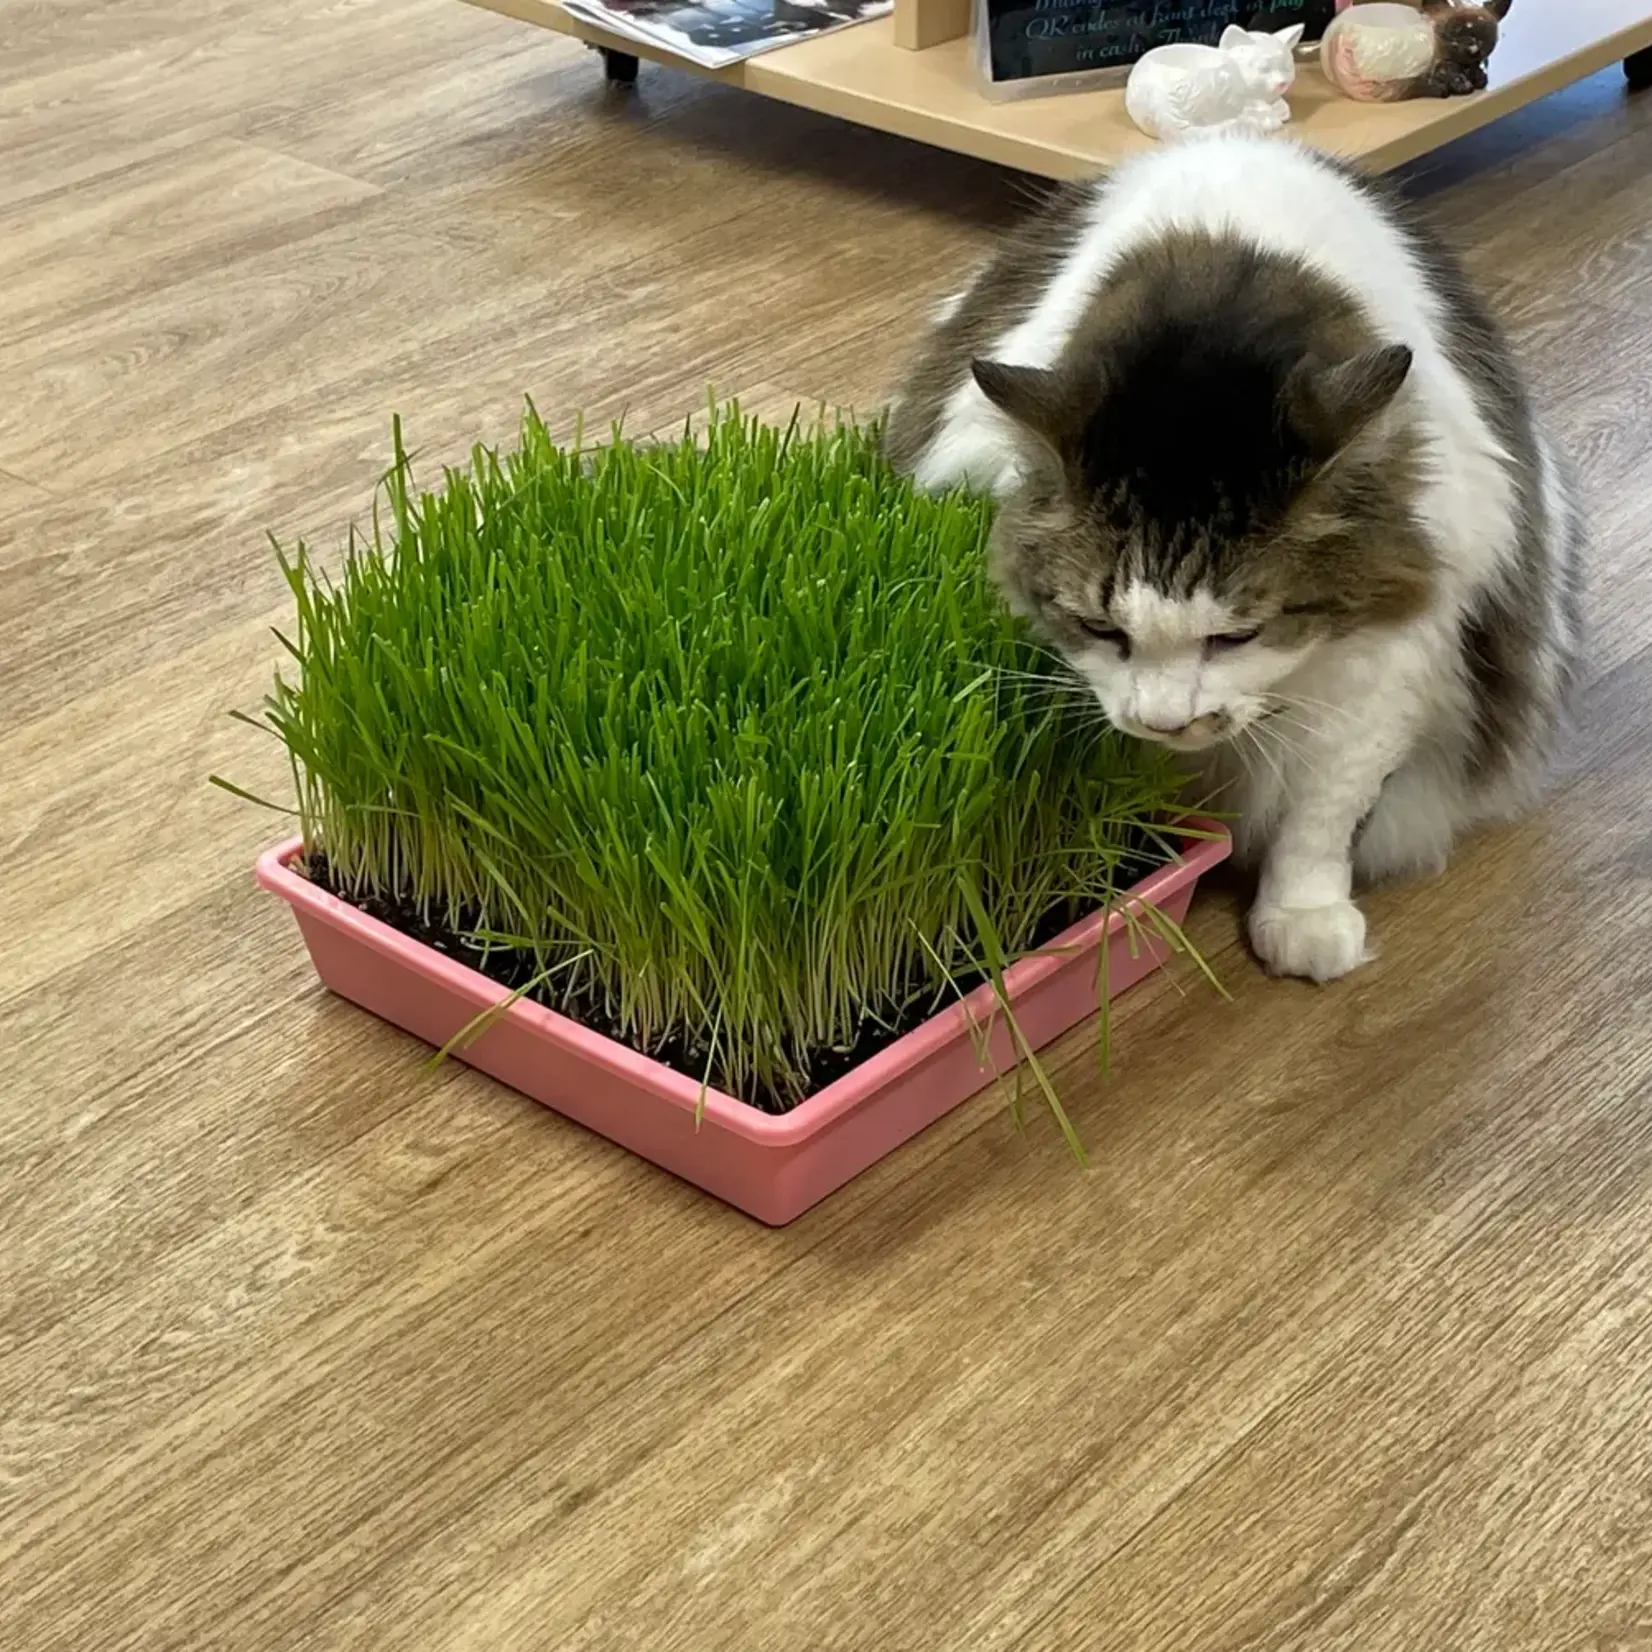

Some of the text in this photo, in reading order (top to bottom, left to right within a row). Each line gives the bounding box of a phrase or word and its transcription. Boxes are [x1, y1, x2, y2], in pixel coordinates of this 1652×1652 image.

[1026, 15, 1068, 40] QR
[1072, 9, 1120, 34] codes
[1076, 45, 1093, 60] in
